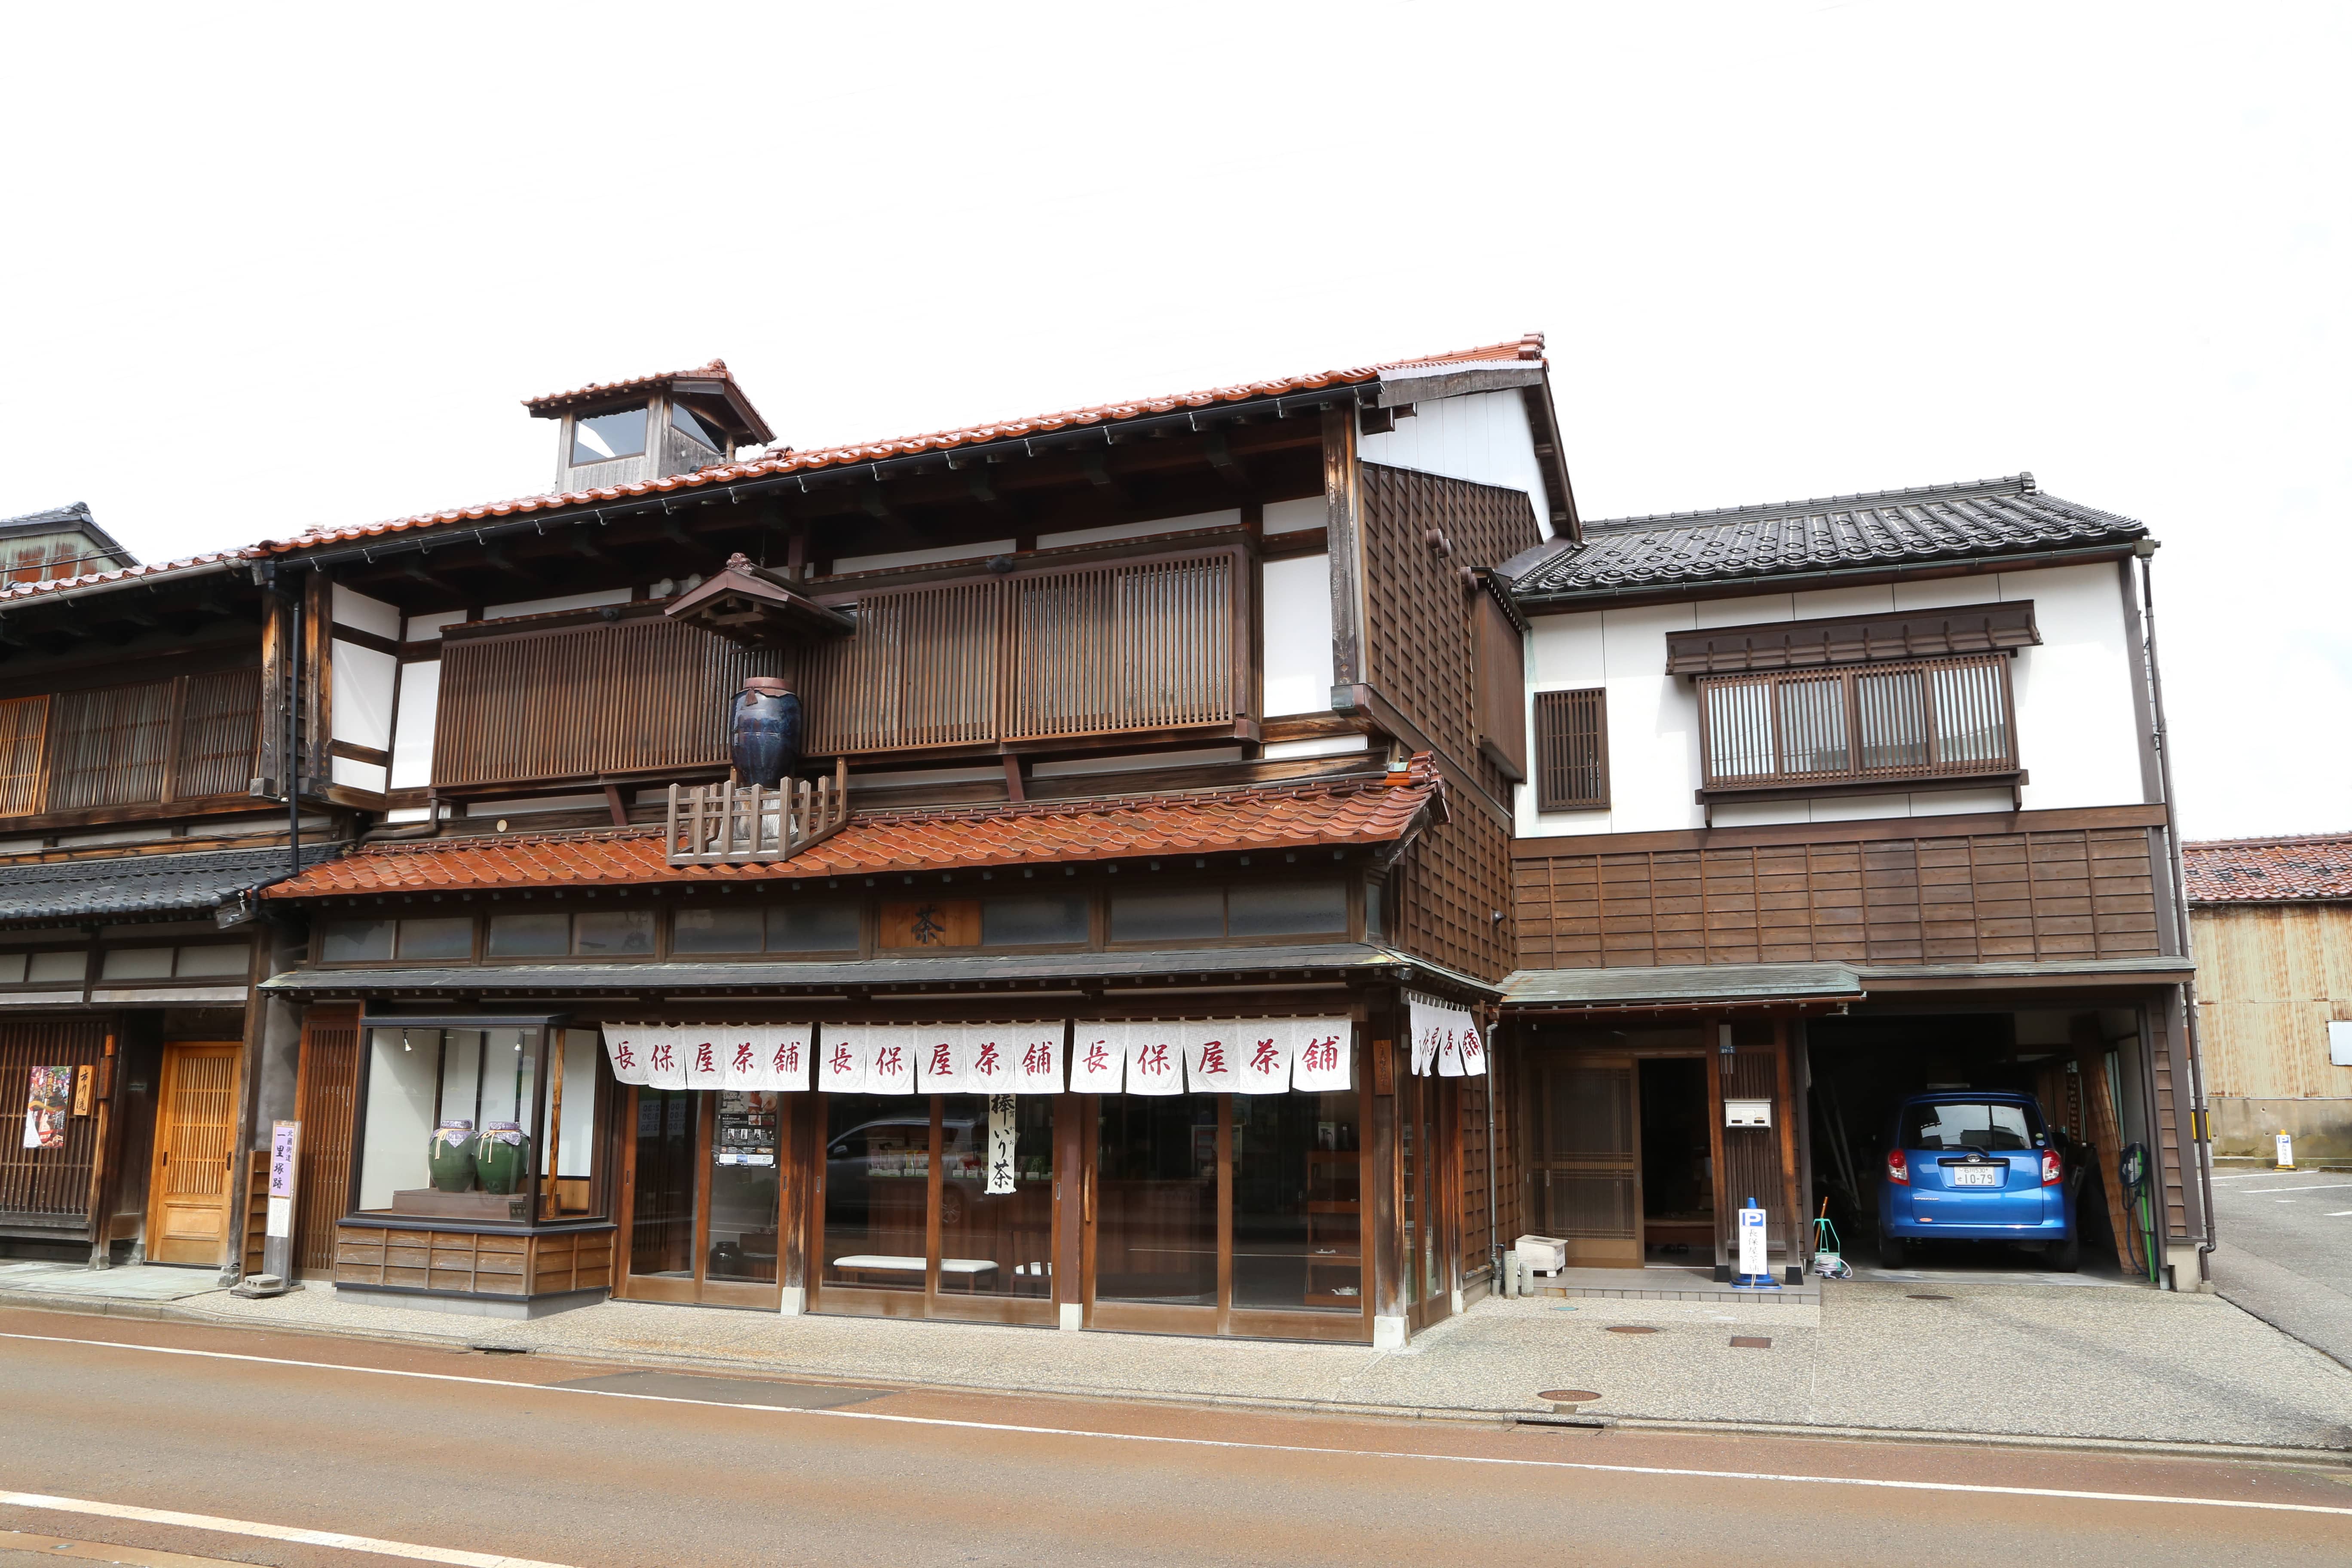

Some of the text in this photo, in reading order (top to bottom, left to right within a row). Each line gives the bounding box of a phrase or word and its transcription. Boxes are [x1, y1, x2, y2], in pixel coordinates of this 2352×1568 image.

[911, 904, 946, 944] 茶
[614, 1041, 800, 1074] 長保屋茶舗
[828, 1041, 1053, 1076] 長保屋茶舗
[1082, 1036, 1339, 1075] 長保屋茶舗
[1419, 1026, 1482, 1060] 保屋茶舗
[76, 1069, 89, 1111] 市川流
[273, 1133, 286, 1189] 一里塚跡
[1965, 1174, 1993, 1184] 10-79
[1745, 1213, 1761, 1226] P
[1748, 1228, 1759, 1272] 長保屋茶舗
